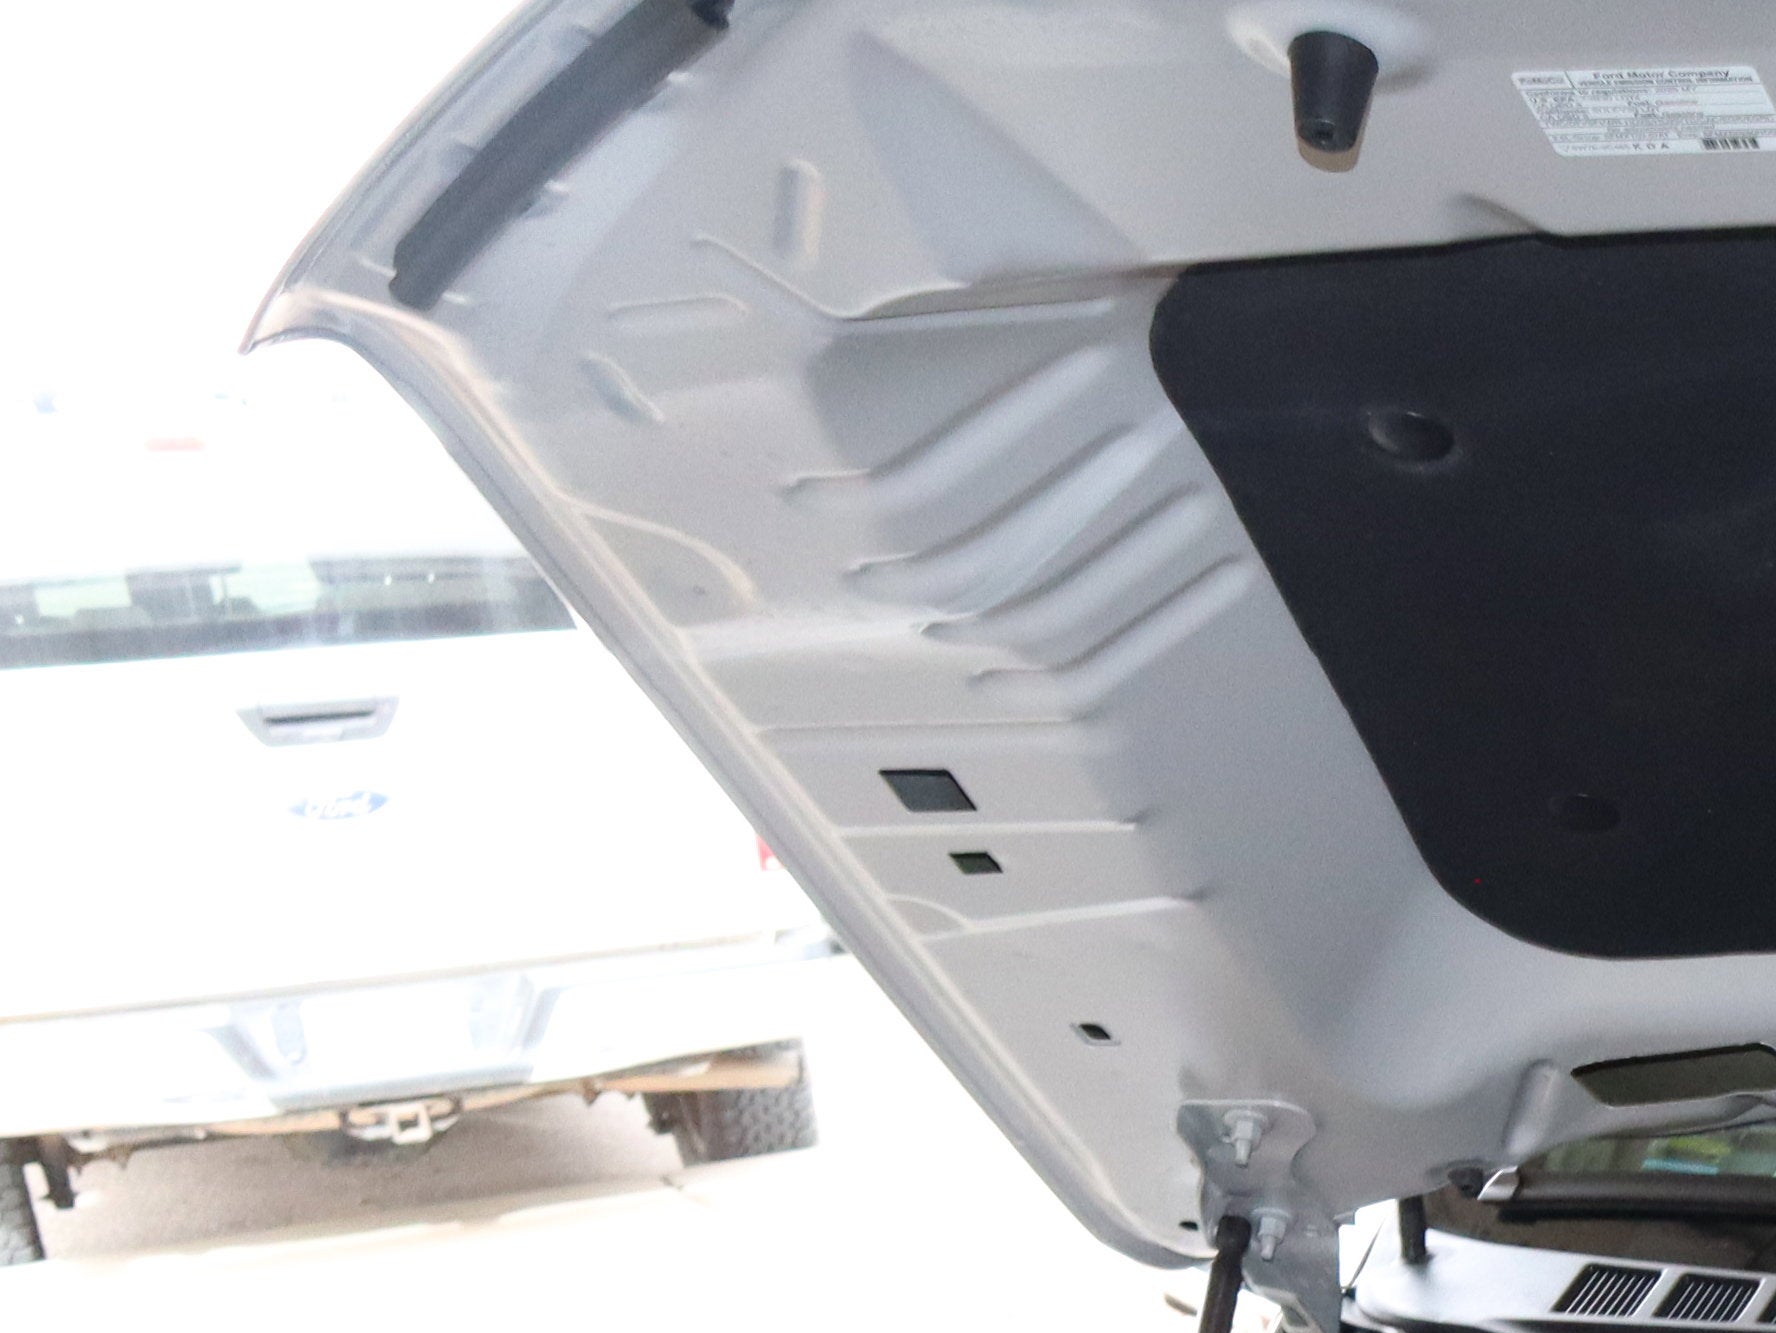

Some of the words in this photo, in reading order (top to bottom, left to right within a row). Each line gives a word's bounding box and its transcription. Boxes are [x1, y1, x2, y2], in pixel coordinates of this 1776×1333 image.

[1592, 72, 1624, 80] Ford
[1627, 71, 1665, 79] Motor
[1667, 69, 1730, 80] Company
